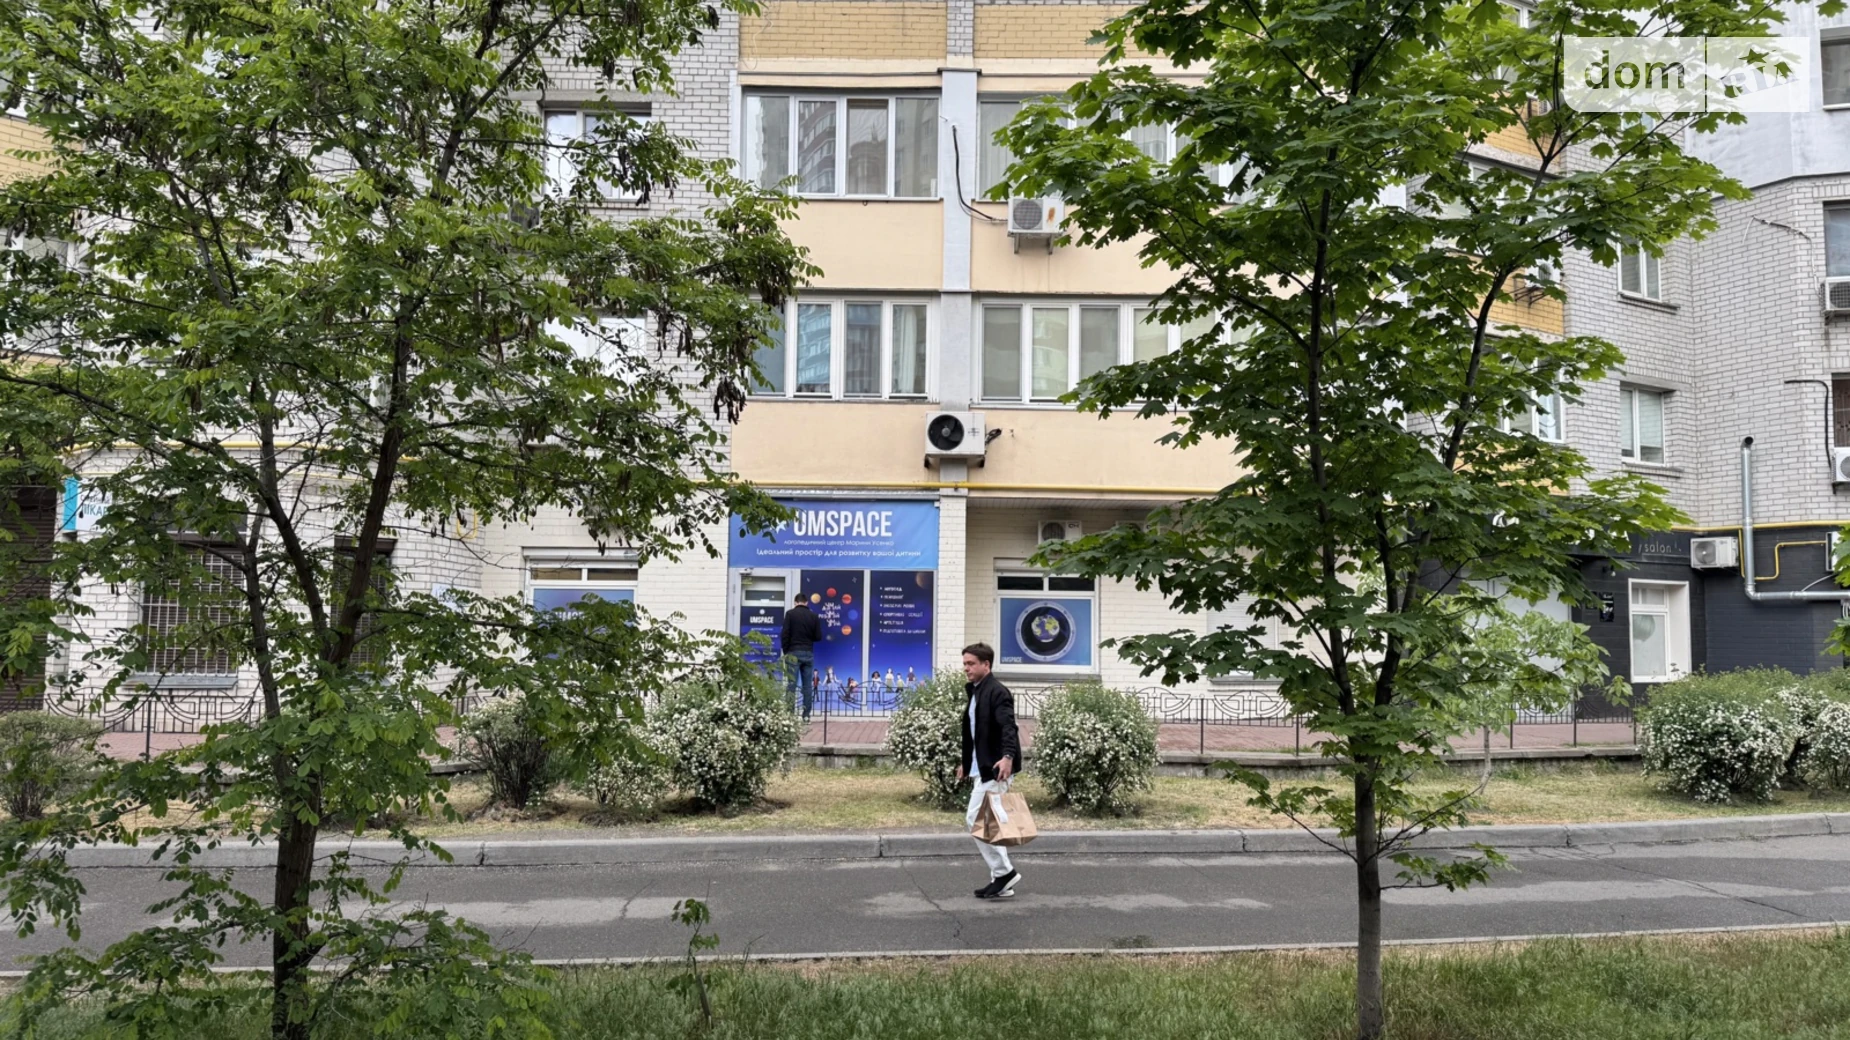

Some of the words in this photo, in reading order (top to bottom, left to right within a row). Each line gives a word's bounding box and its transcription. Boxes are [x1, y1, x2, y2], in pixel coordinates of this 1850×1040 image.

[793, 510, 893, 537] UMSPACE
[1644, 541, 1671, 553] salon
[750, 616, 774, 624] UMSPACE
